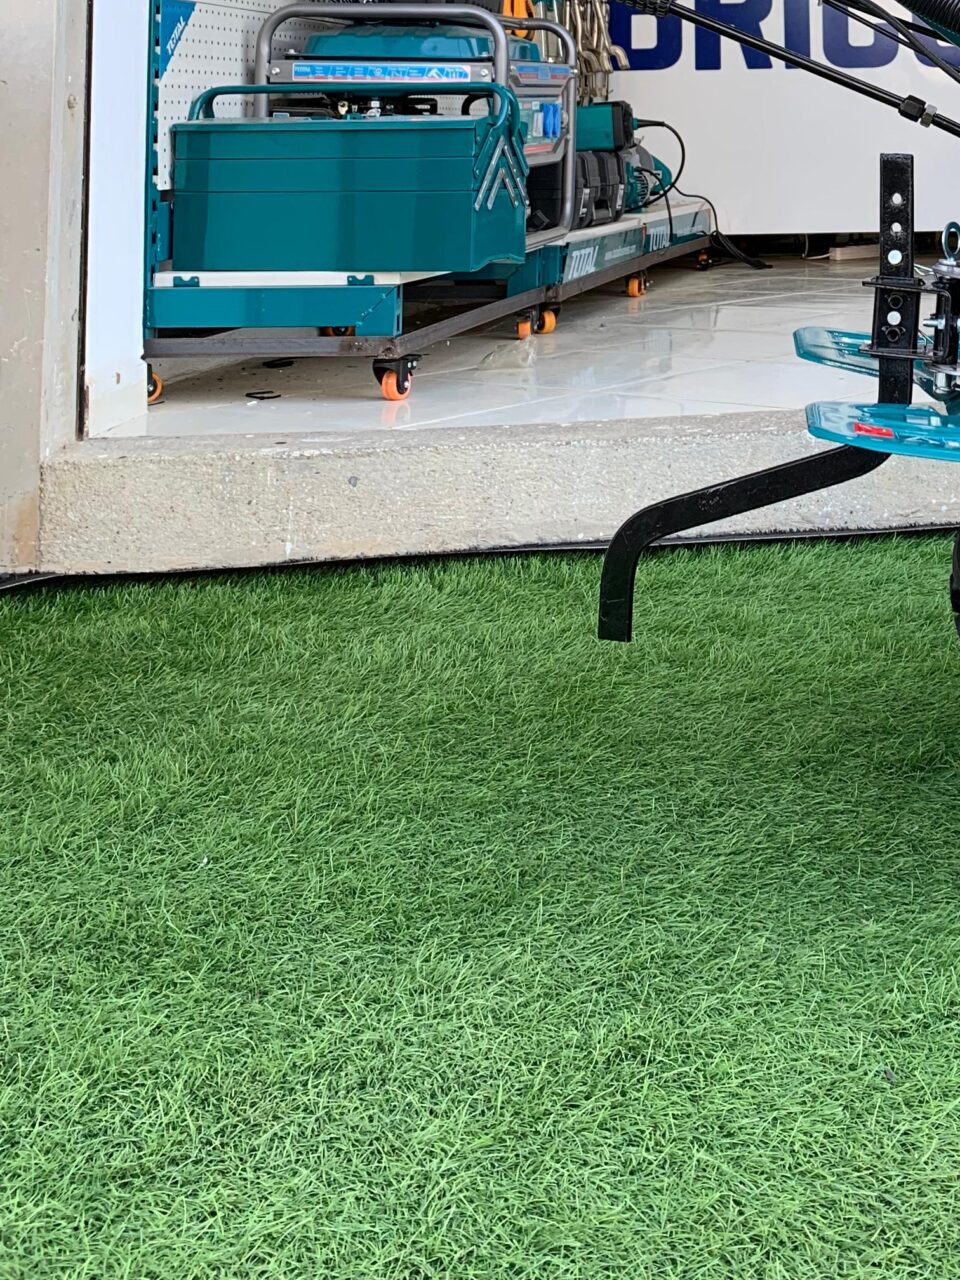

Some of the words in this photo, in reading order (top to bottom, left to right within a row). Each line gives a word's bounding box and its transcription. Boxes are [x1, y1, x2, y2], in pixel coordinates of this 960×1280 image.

[166, 16, 186, 56] TOTAL
[650, 225, 671, 252] TOTAL
[568, 245, 599, 280] TOTAL
